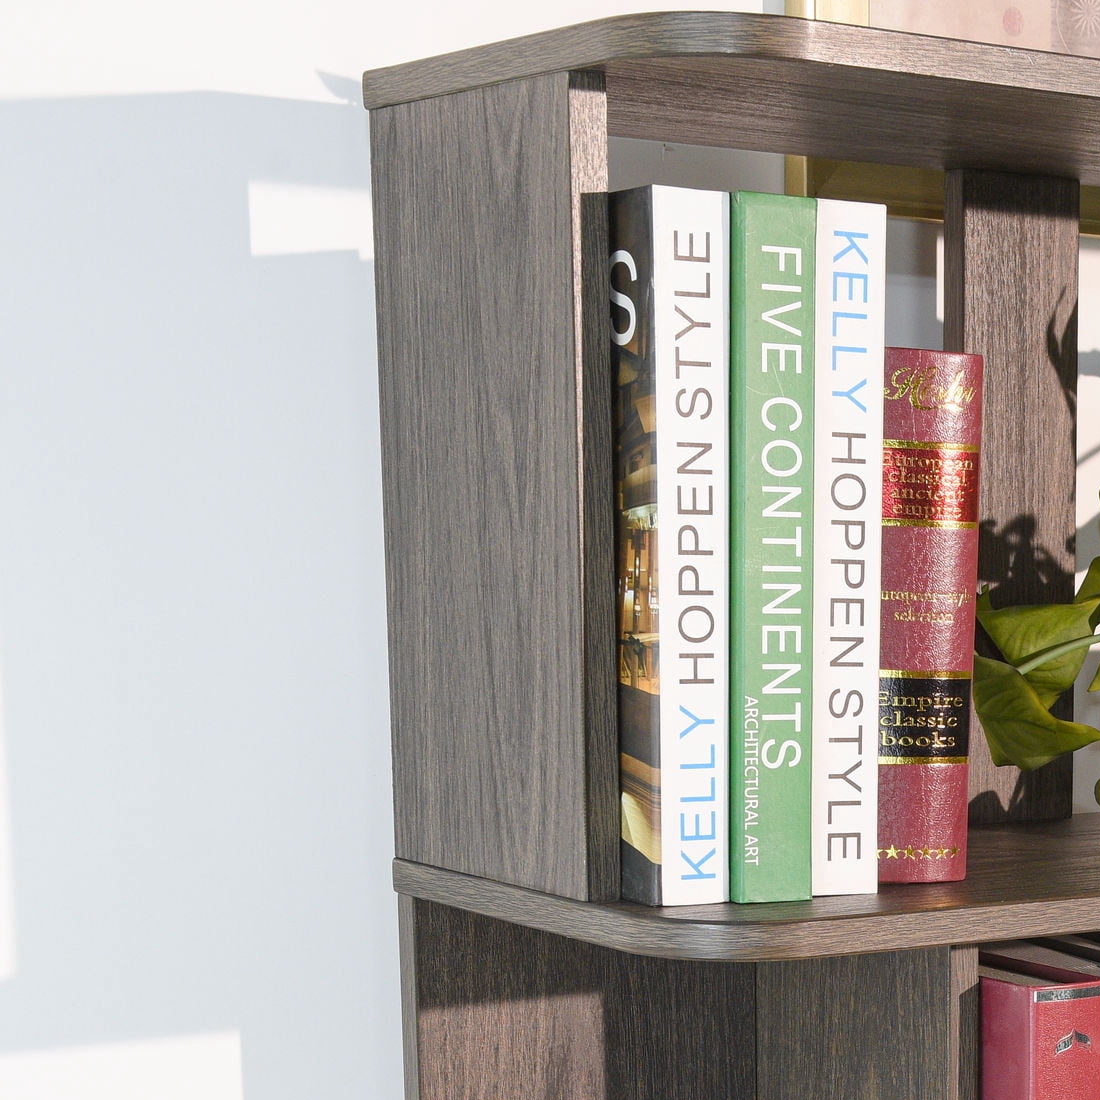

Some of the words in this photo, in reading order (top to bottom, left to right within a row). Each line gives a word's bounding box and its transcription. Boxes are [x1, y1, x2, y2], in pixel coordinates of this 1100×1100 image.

[673, 230, 713, 420] STYLE
[761, 244, 803, 374] FIVE
[831, 231, 869, 413] KELLY
[882, 451, 974, 472] European
[676, 441, 715, 685] HOPPEN
[760, 397, 803, 769] CONTINENTS
[829, 431, 867, 667] HOPPEN
[744, 695, 760, 830] ARCHITECTURAL
[827, 688, 864, 862] STYLE
[878, 692, 963, 711] Empire
[880, 711, 958, 728] classic
[880, 731, 956, 748] books
[679, 704, 716, 881] KELLY
[744, 835, 760, 866] ART
